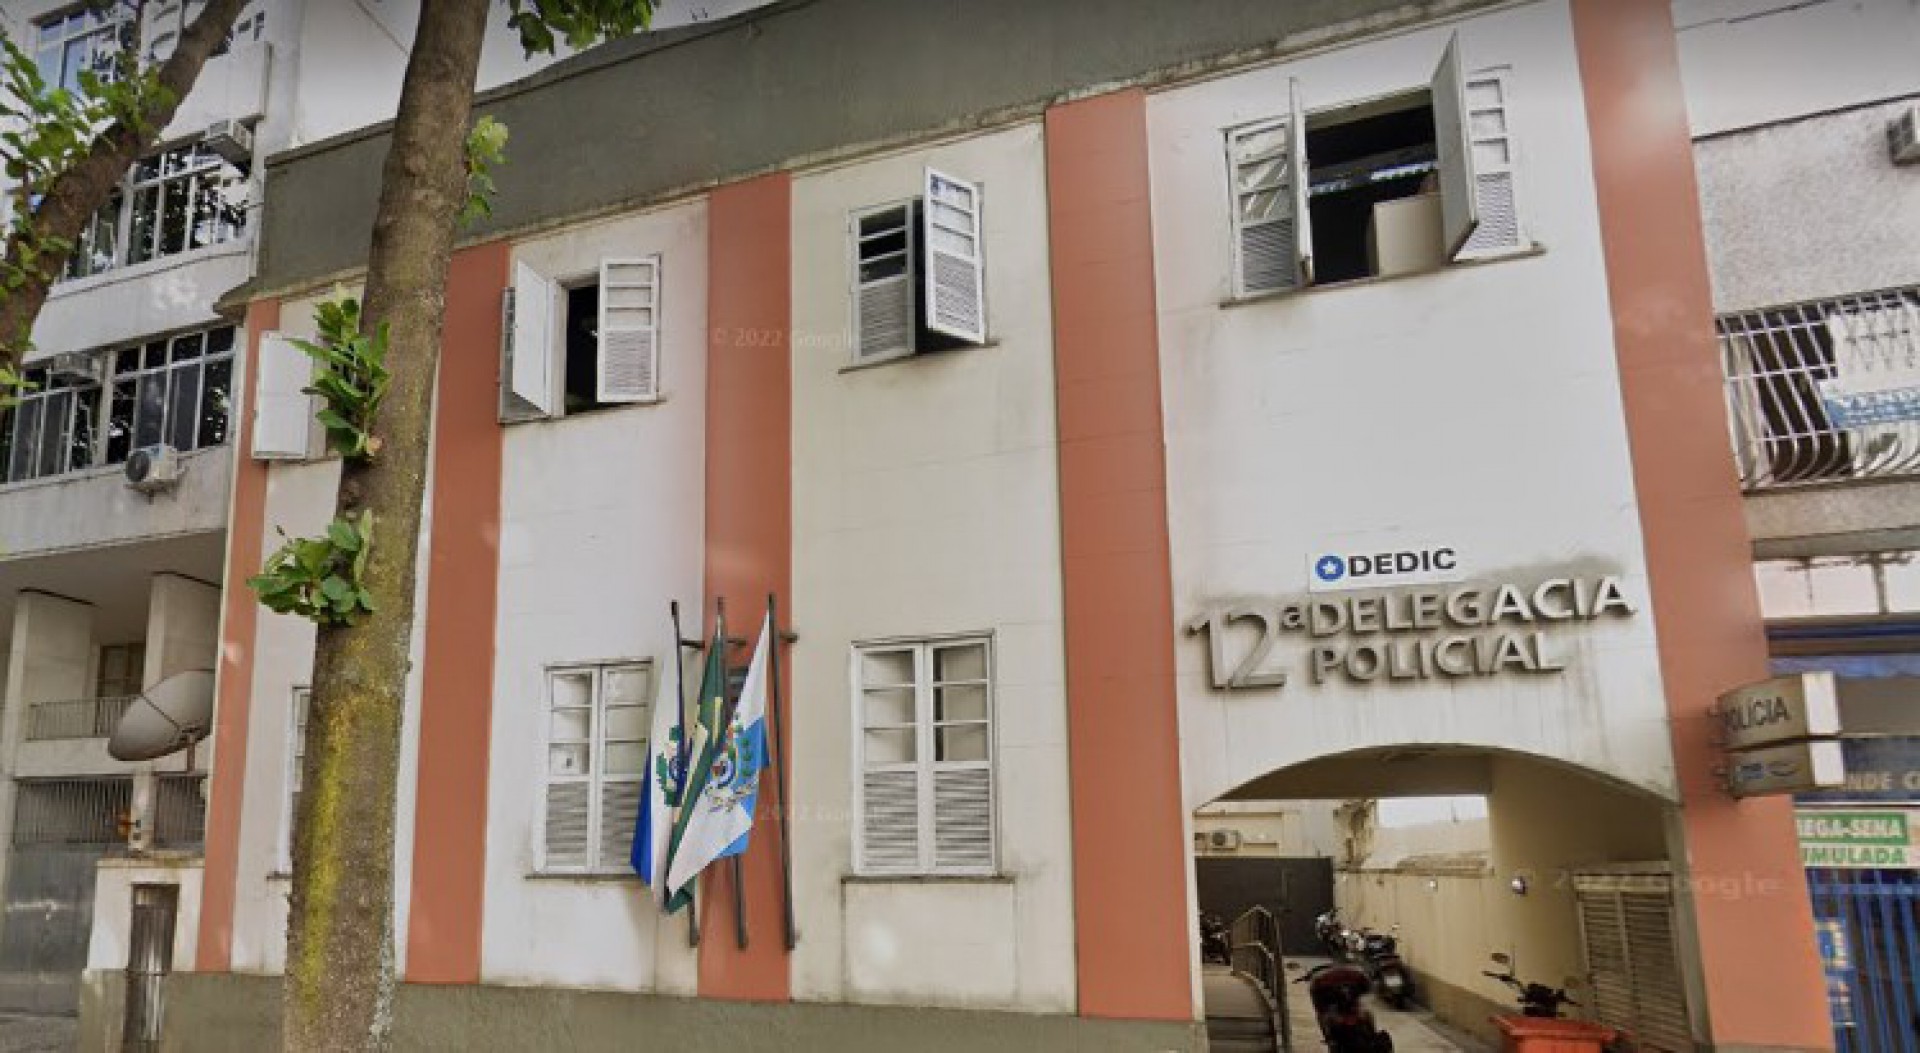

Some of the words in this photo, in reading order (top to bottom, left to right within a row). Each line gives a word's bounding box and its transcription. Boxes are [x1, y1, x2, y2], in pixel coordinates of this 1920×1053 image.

[1348, 547, 1457, 578] DEDIC
[1310, 574, 1637, 638] DELEGACIA
[1313, 631, 1564, 685] POLICIAL
